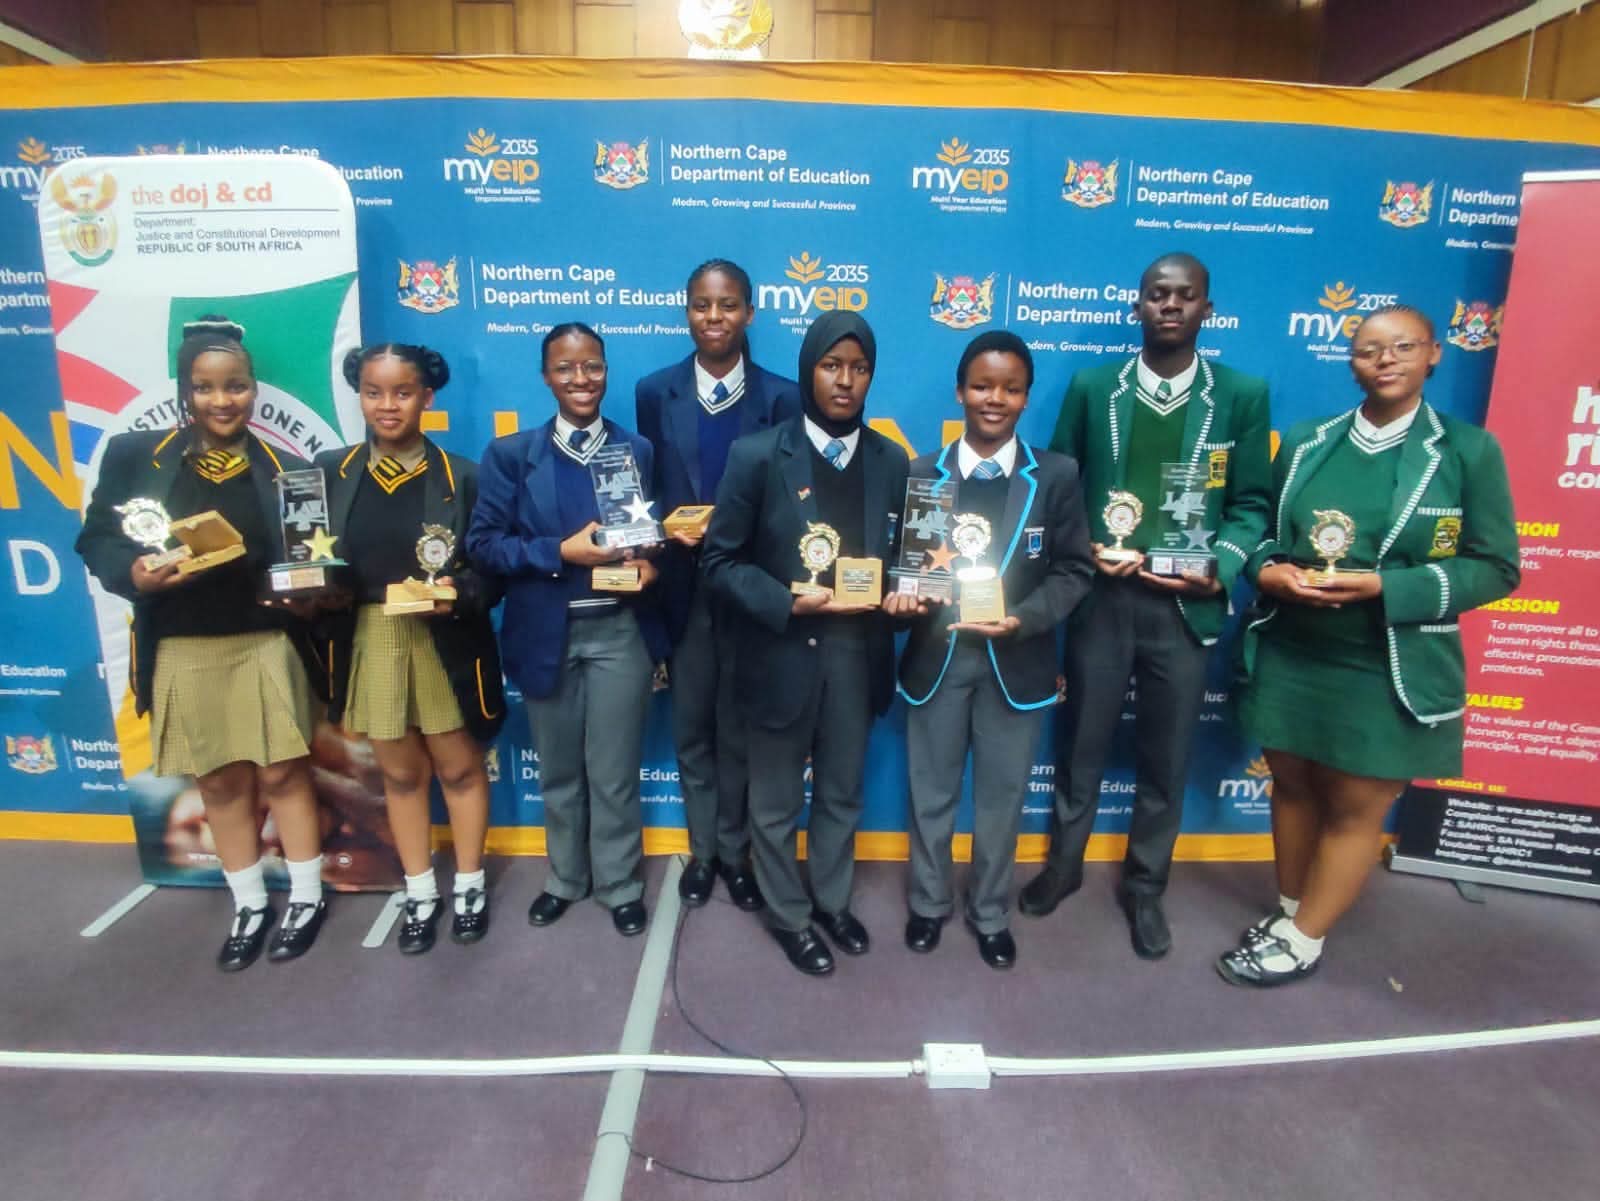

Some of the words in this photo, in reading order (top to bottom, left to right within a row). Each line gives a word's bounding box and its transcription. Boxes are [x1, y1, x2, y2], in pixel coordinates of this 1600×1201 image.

[501, 139, 539, 155] 2035
[670, 144, 741, 160] Northern
[746, 144, 787, 164] Cape
[973, 148, 1010, 165] 2035
[337, 165, 403, 180] ucation
[443, 158, 540, 185] myeip
[671, 165, 764, 183] Department
[768, 167, 785, 182] of
[788, 167, 870, 185] Education
[1138, 166, 1208, 184] Northern
[1212, 169, 1253, 188] Cape
[912, 167, 1009, 195] myeip
[131, 185, 164, 205] the
[170, 183, 208, 209] doj
[216, 181, 235, 203] &
[244, 181, 273, 203] cd
[672, 197, 709, 208] Modern,
[711, 197, 750, 210] Growing
[752, 198, 769, 208] and
[772, 199, 816, 209] Successful
[818, 200, 856, 211] Province
[1136, 187, 1228, 205] Department
[1231, 191, 1249, 206] of
[1251, 192, 1330, 210] Education
[1451, 188, 1516, 206] Northern
[1448, 208, 1519, 227] Departme
[136, 231, 171, 242] Justice
[174, 229, 193, 241] and
[196, 228, 267, 240] Constitutional
[270, 228, 341, 242] Development
[1174, 219, 1211, 233] Growing
[1213, 221, 1231, 231] and
[1232, 221, 1276, 233] Successful
[1277, 223, 1314, 235] Province
[138, 243, 194, 254] REPUBLIC
[197, 242, 212, 253] OF
[216, 241, 256, 252] SOUTH
[259, 240, 303, 252] AFRICA
[0, 267, 45, 284] thern
[482, 264, 563, 281] Northern
[568, 264, 616, 285] Cape
[826, 264, 869, 283] 2035
[484, 287, 591, 307] Department
[595, 288, 614, 305] of
[619, 288, 688, 306] Educati
[1018, 281, 1098, 301] Northern
[1103, 285, 1140, 305] Cap
[1016, 305, 1121, 326] Department
[487, 322, 529, 334] Modern,
[600, 323, 652, 335] Successful
[654, 324, 691, 335] Provinc
[1288, 312, 1364, 343] mye
[1060, 341, 1102, 354] Growing
[1105, 342, 1125, 353] and
[260, 402, 305, 440] ONE
[1491, 619, 1506, 630] To
[1508, 622, 1567, 634] empower
[1567, 625, 1585, 636] all
[1585, 627, 1598, 637] to
[1488, 634, 1529, 646] human
[1531, 638, 1567, 650] rights
[1484, 648, 1535, 661] effective
[1480, 663, 1545, 677] protection.
[1470, 712, 1491, 723] The
[1493, 716, 1531, 728] values
[1533, 719, 1547, 729] of
[1547, 720, 1569, 732] the
